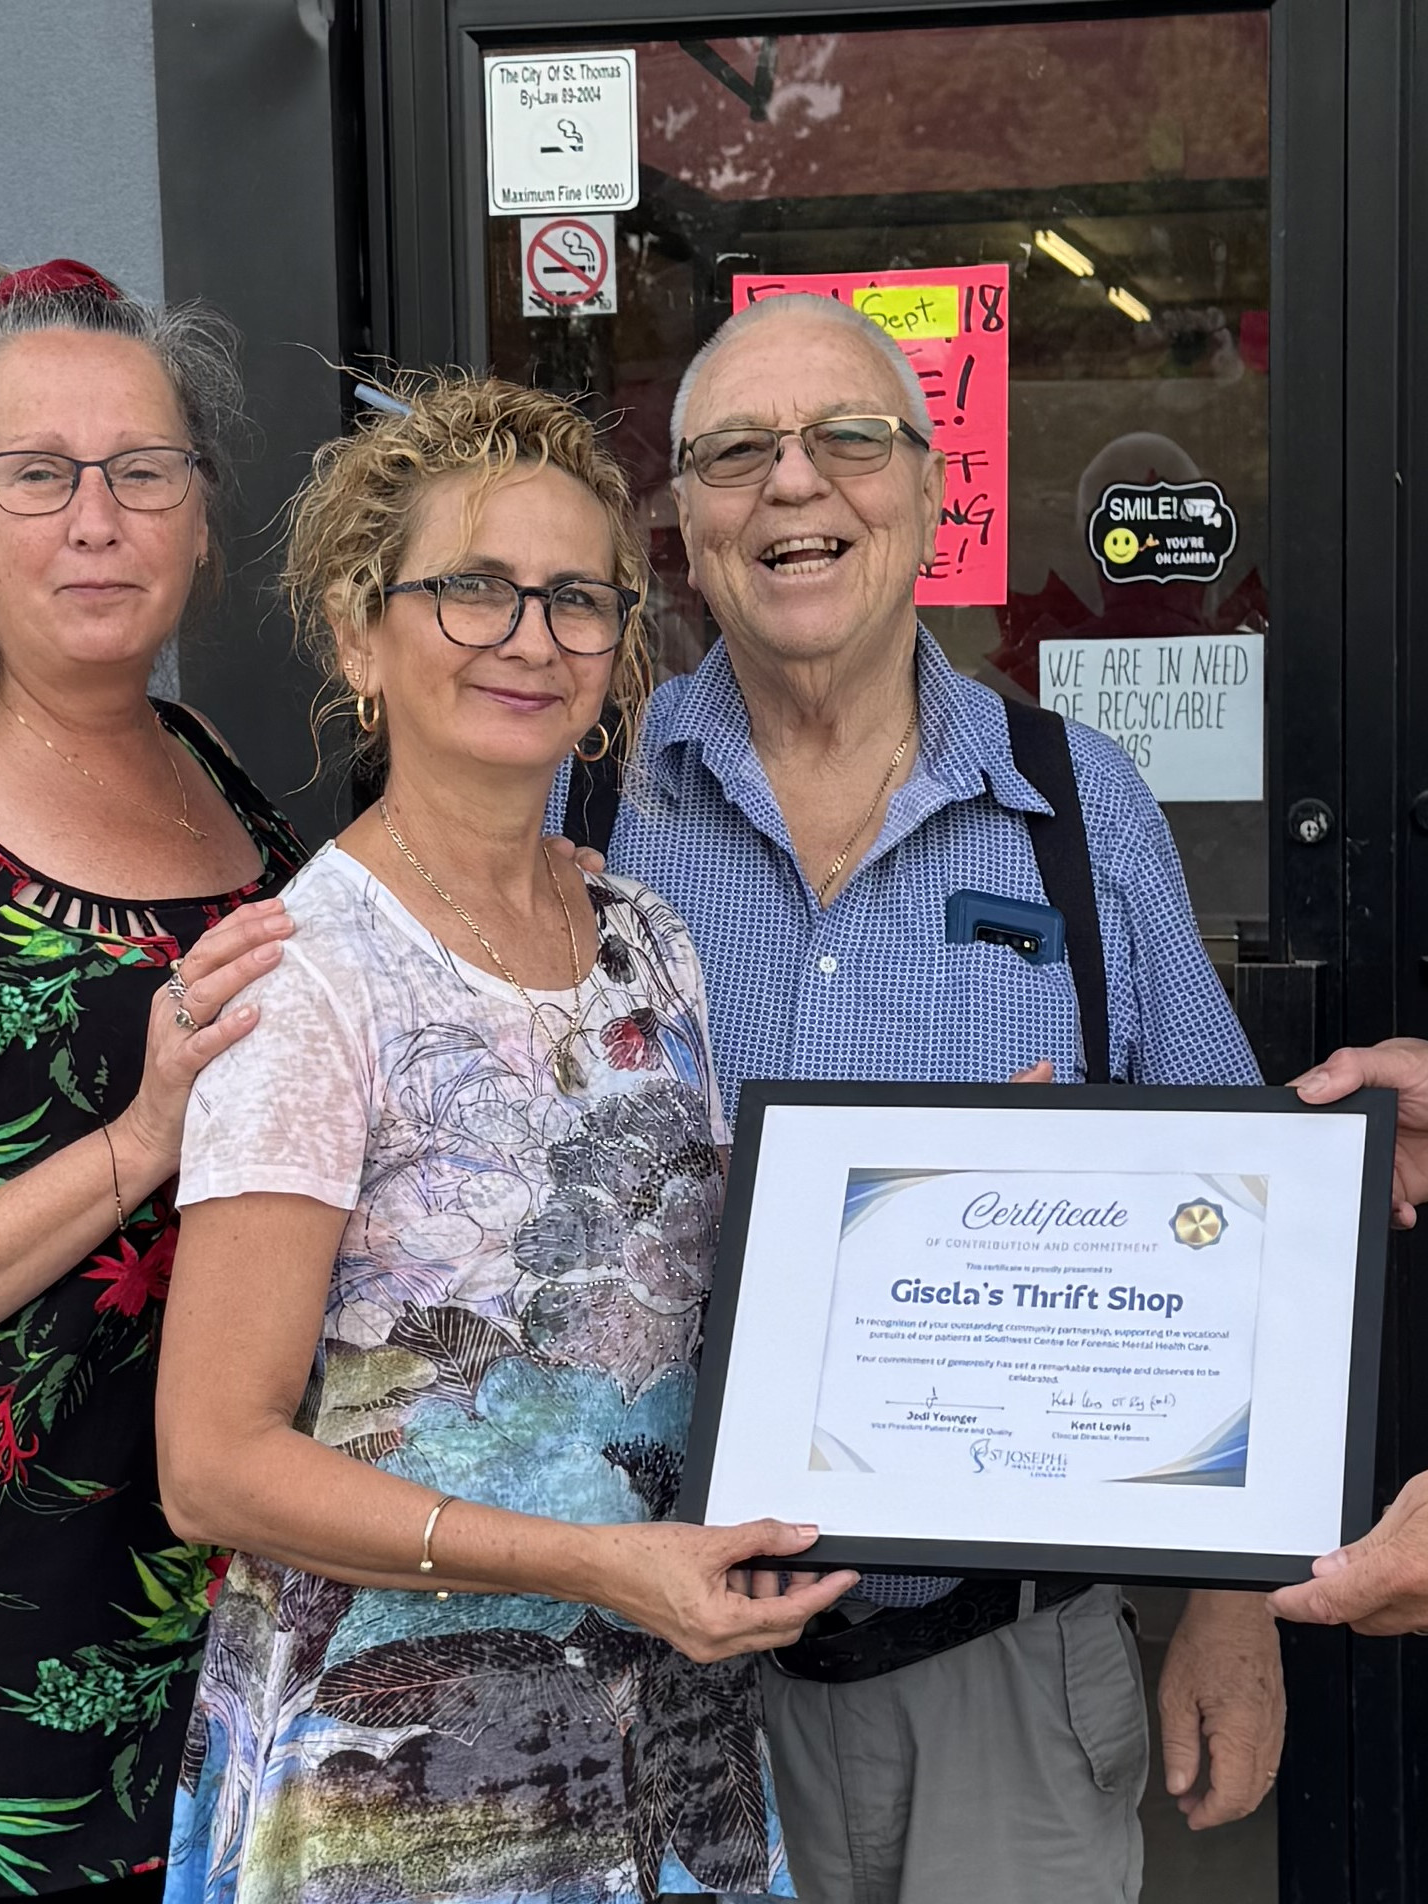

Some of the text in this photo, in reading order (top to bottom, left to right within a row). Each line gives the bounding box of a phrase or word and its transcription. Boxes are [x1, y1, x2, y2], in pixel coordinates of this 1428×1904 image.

[500, 68, 518, 84] The
[521, 66, 541, 86] City
[548, 65, 559, 81] Of
[580, 63, 621, 80] Thomas
[520, 89, 558, 109] By-Law
[502, 187, 556, 205] Maximum
[558, 186, 582, 202] Fine
[964, 284, 1004, 333] 18
[1109, 497, 1179, 521] SMILE!
[1165, 536, 1204, 550] YOU'RE
[1155, 551, 1216, 565] ON CAMERA
[1048, 644, 1249, 688] WE ARE IN NEED
[1098, 691, 1227, 731] RECYCLABLE
[962, 1191, 1128, 1235] Certificate
[926, 1238, 1159, 1253] OF CONTRIBUTION AND COMMITMENT
[891, 1278, 1184, 1318] Gisela's Thrift Shop
[866, 1318, 916, 1329] recognition
[929, 1320, 948, 1330] your
[951, 1320, 1003, 1332] outstanding
[1005, 1323, 1056, 1334] community
[1115, 1328, 1164, 1339] supporting
[1166, 1329, 1180, 1338] the
[1183, 1330, 1230, 1339] vocational
[935, 1333, 970, 1343] patients
[985, 1334, 1031, 1344] Southwest
[1081, 1338, 1119, 1348] Forensic
[1155, 1341, 1185, 1351] Health
[1188, 1342, 1211, 1352] Care.
[856, 1354, 876, 1363] Your
[1093, 1365, 1132, 1376] example
[1134, 1367, 1151, 1376] and
[933, 1412, 977, 1424] Younger
[1071, 1421, 1096, 1431] Kent
